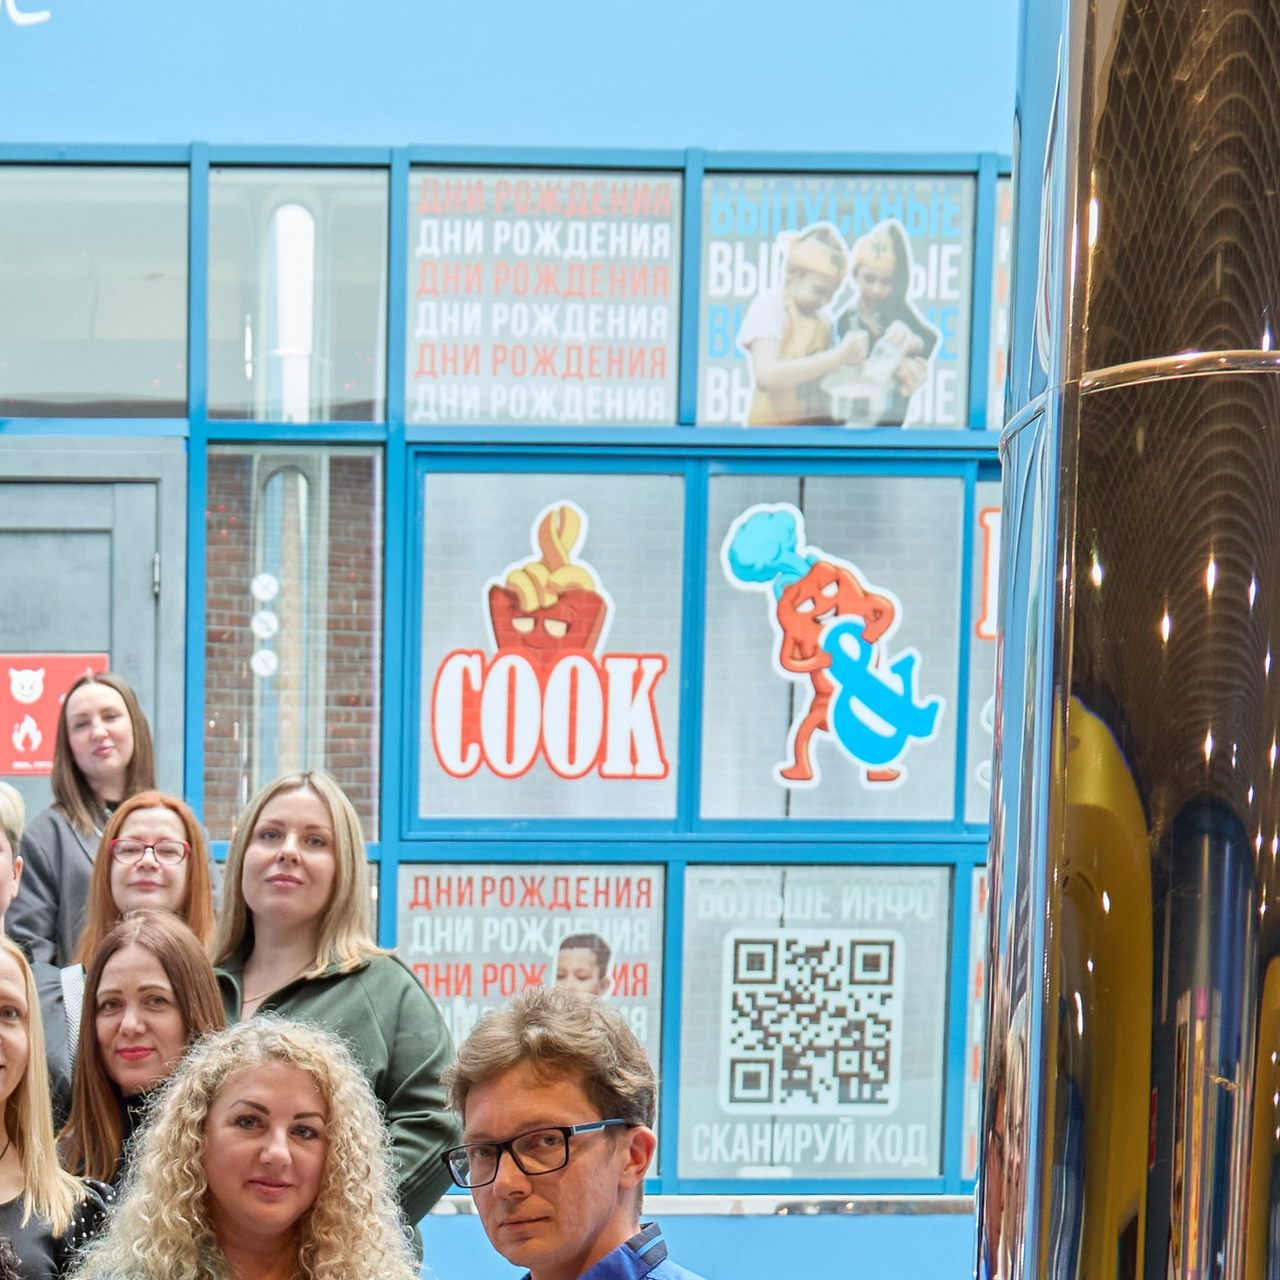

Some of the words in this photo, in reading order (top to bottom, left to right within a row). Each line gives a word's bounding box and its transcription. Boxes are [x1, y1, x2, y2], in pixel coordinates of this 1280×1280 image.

[417, 178, 484, 214] ДНИ
[494, 179, 671, 217] РОЖДЕНИЯ
[415, 218, 484, 257] ДНИ
[493, 219, 671, 260] РОЖДЕНИЯ
[416, 261, 483, 297] ДНИ
[493, 262, 669, 300] РОЖДЕНИЯ
[414, 301, 482, 339] ДНИ
[492, 302, 669, 341] РОЖДЕНИЯ
[414, 343, 481, 379] ДНИ
[491, 344, 666, 380] РОЖДЕНИЯ
[413, 383, 481, 422] ДНИ
[490, 384, 666, 423] РОЖДЕНИЯ
[432, 649, 669, 779] COOK
[410, 875, 473, 909] ДНИ
[481, 875, 652, 910] РОЖДЕНИЯ
[696, 878, 832, 920] БОЛЬШЕ
[840, 878, 935, 922] ИНФО
[408, 916, 473, 954] ДНИ
[691, 1117, 854, 1163] СКАНИРУЙ
[864, 1123, 928, 1167] КОД
